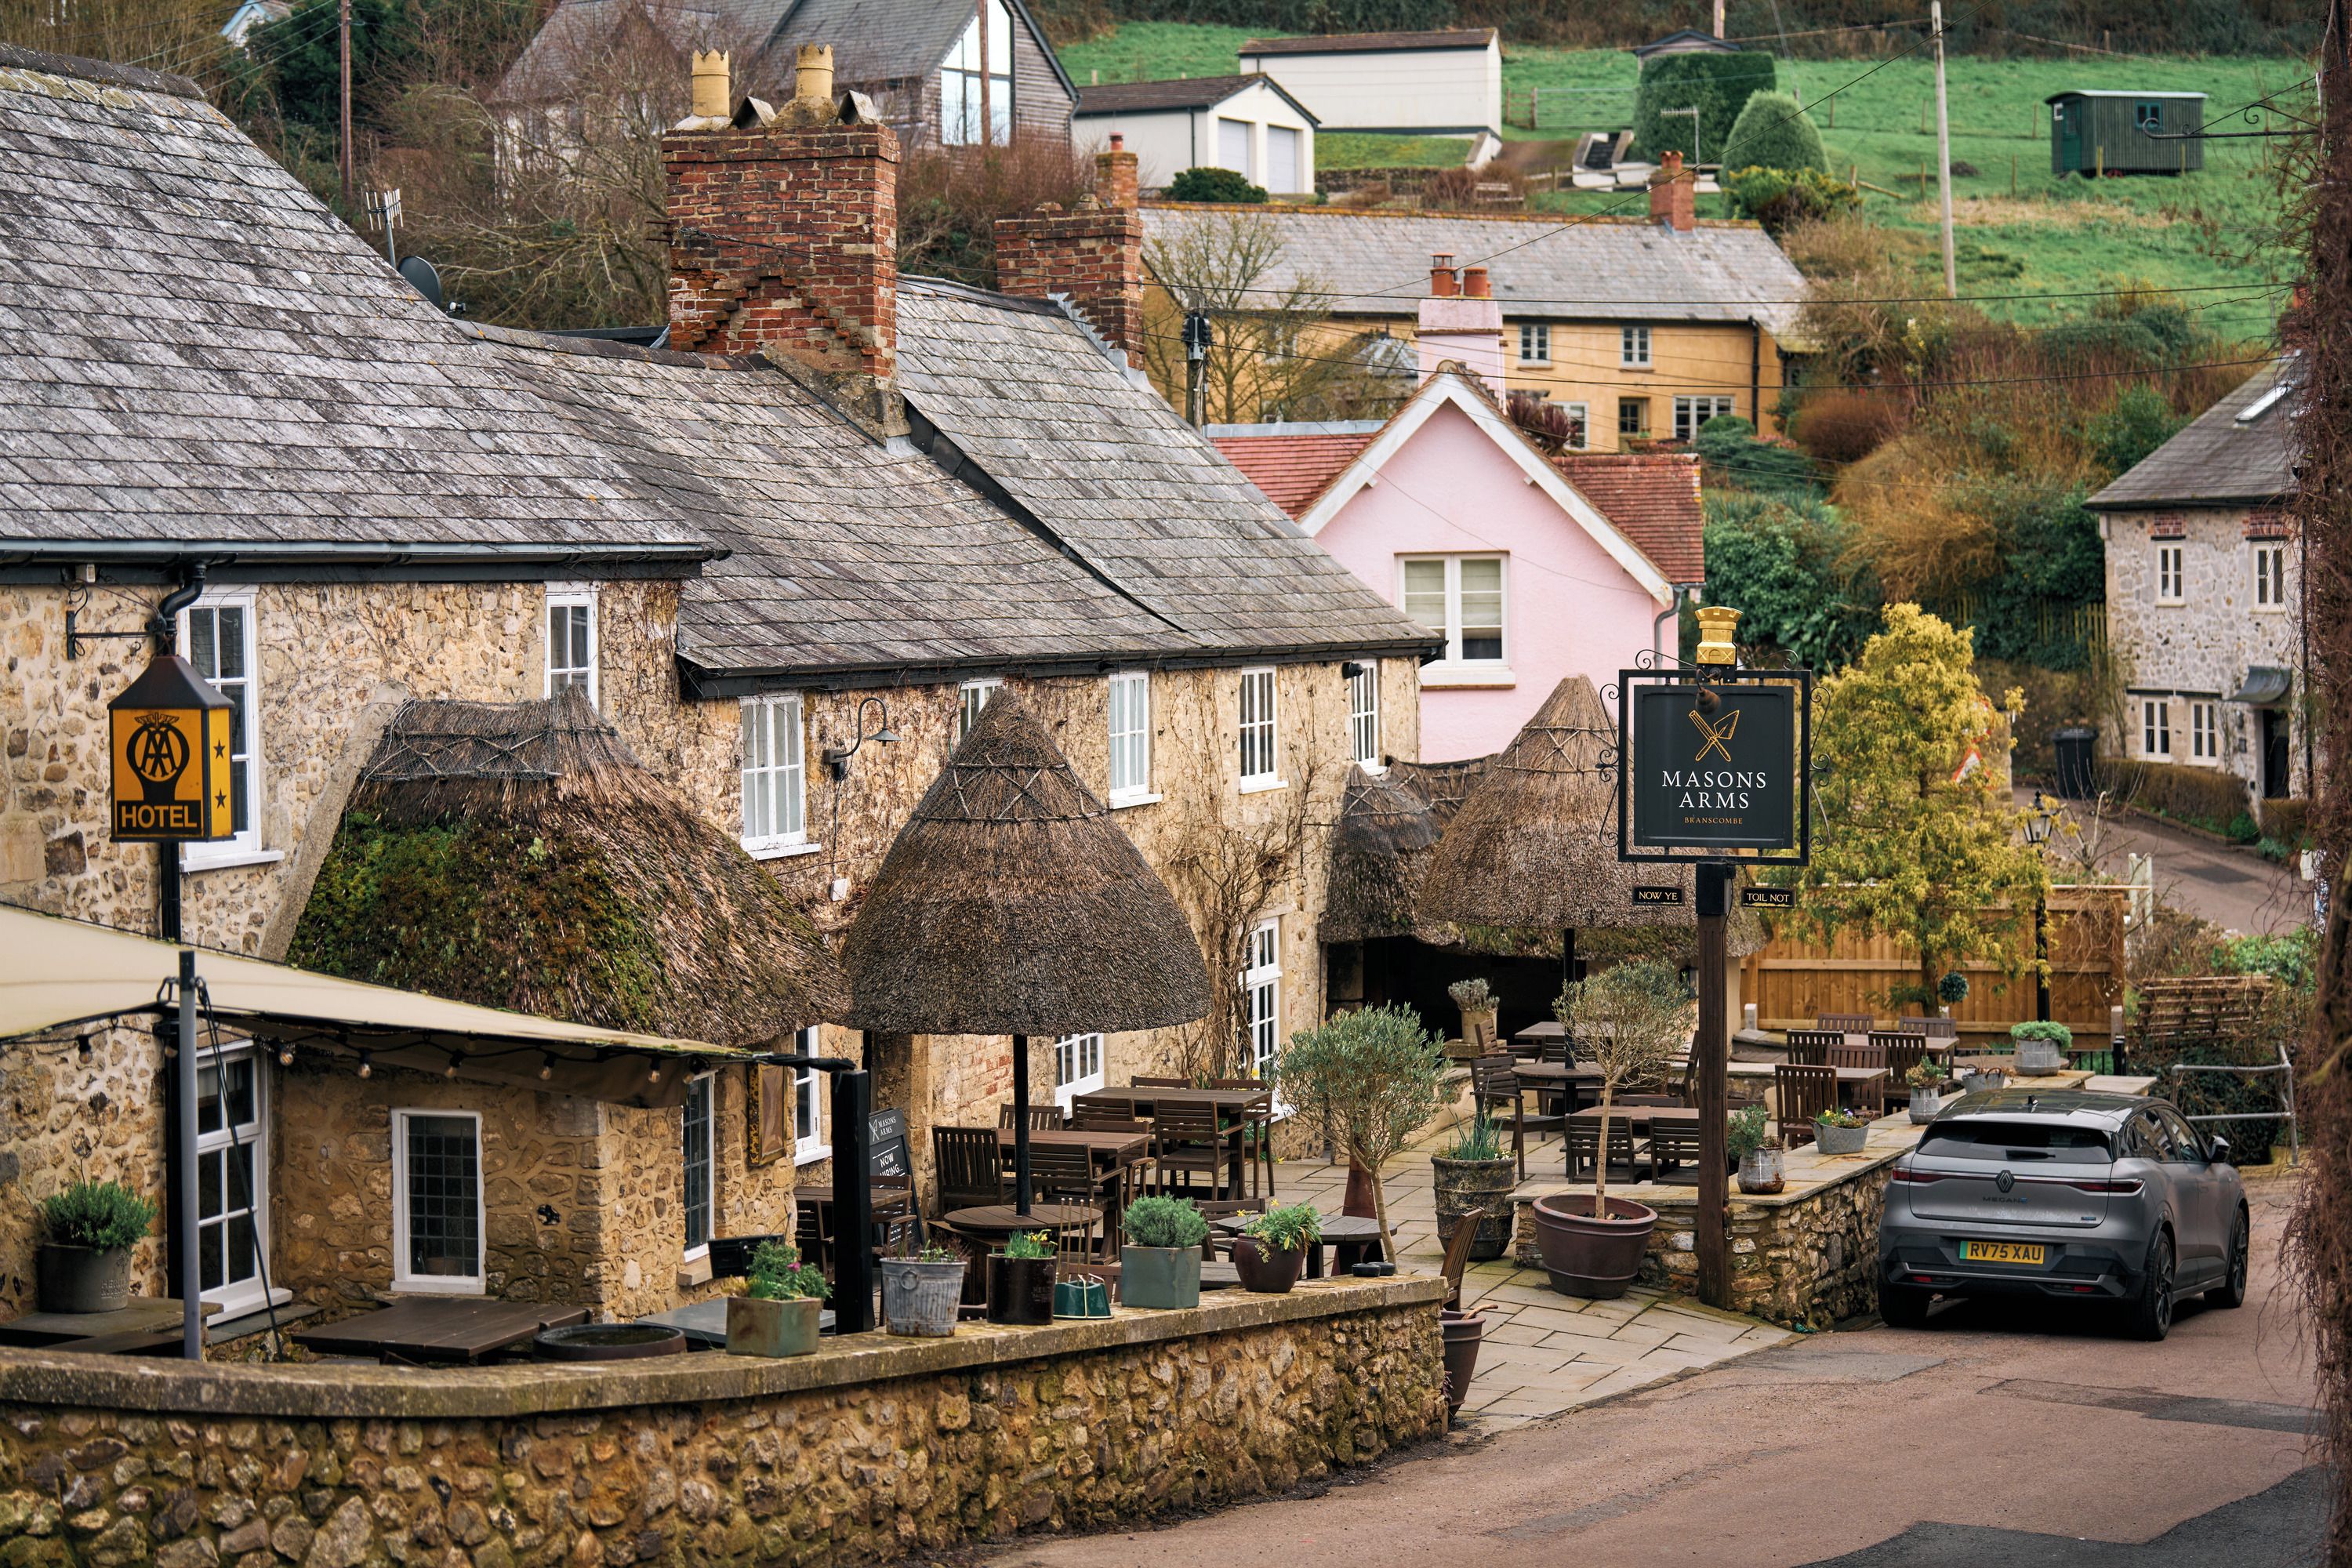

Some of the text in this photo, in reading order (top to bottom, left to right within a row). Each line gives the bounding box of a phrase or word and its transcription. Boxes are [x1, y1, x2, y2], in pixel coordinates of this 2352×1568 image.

[1661, 771, 1767, 789] MASONS
[1679, 792, 1750, 809] ARMS
[121, 804, 198, 828] HOTEL
[1684, 816, 1743, 825] BRANSCOMBE
[1639, 891, 1678, 901] NOW YE
[1747, 893, 1790, 902] TOIL NOT
[877, 1116, 897, 1129] MASONS
[880, 1126, 893, 1137] ARMS
[879, 1152, 894, 1168] NOW
[1970, 1243, 2041, 1261] RV75 XAU
